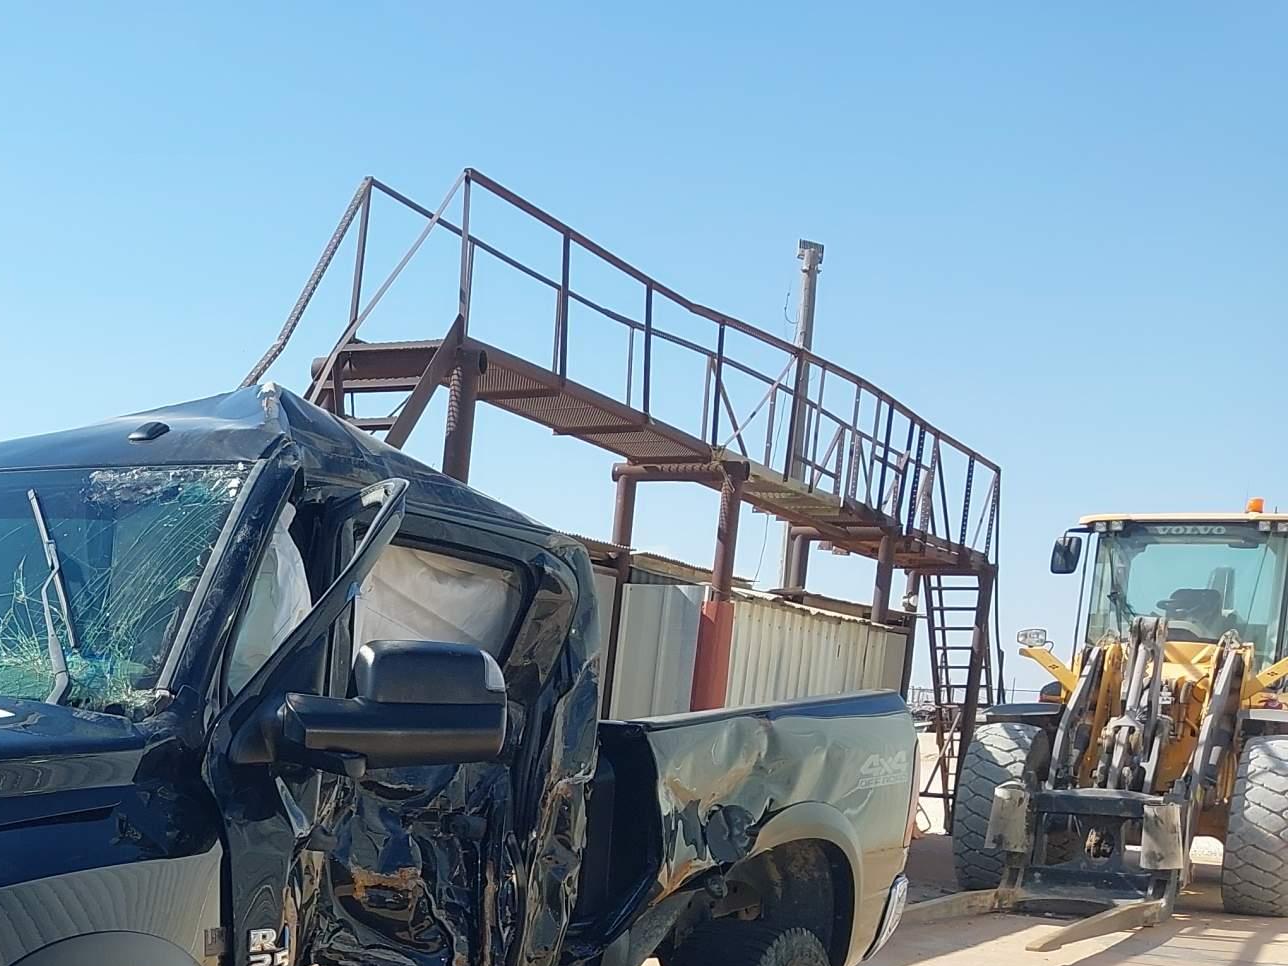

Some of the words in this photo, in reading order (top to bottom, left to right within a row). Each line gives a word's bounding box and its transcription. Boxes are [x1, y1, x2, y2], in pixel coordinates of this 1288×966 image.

[1155, 526, 1226, 534] VOLVO
[860, 751, 909, 776] 4x4
[859, 777, 881, 788] OFF
